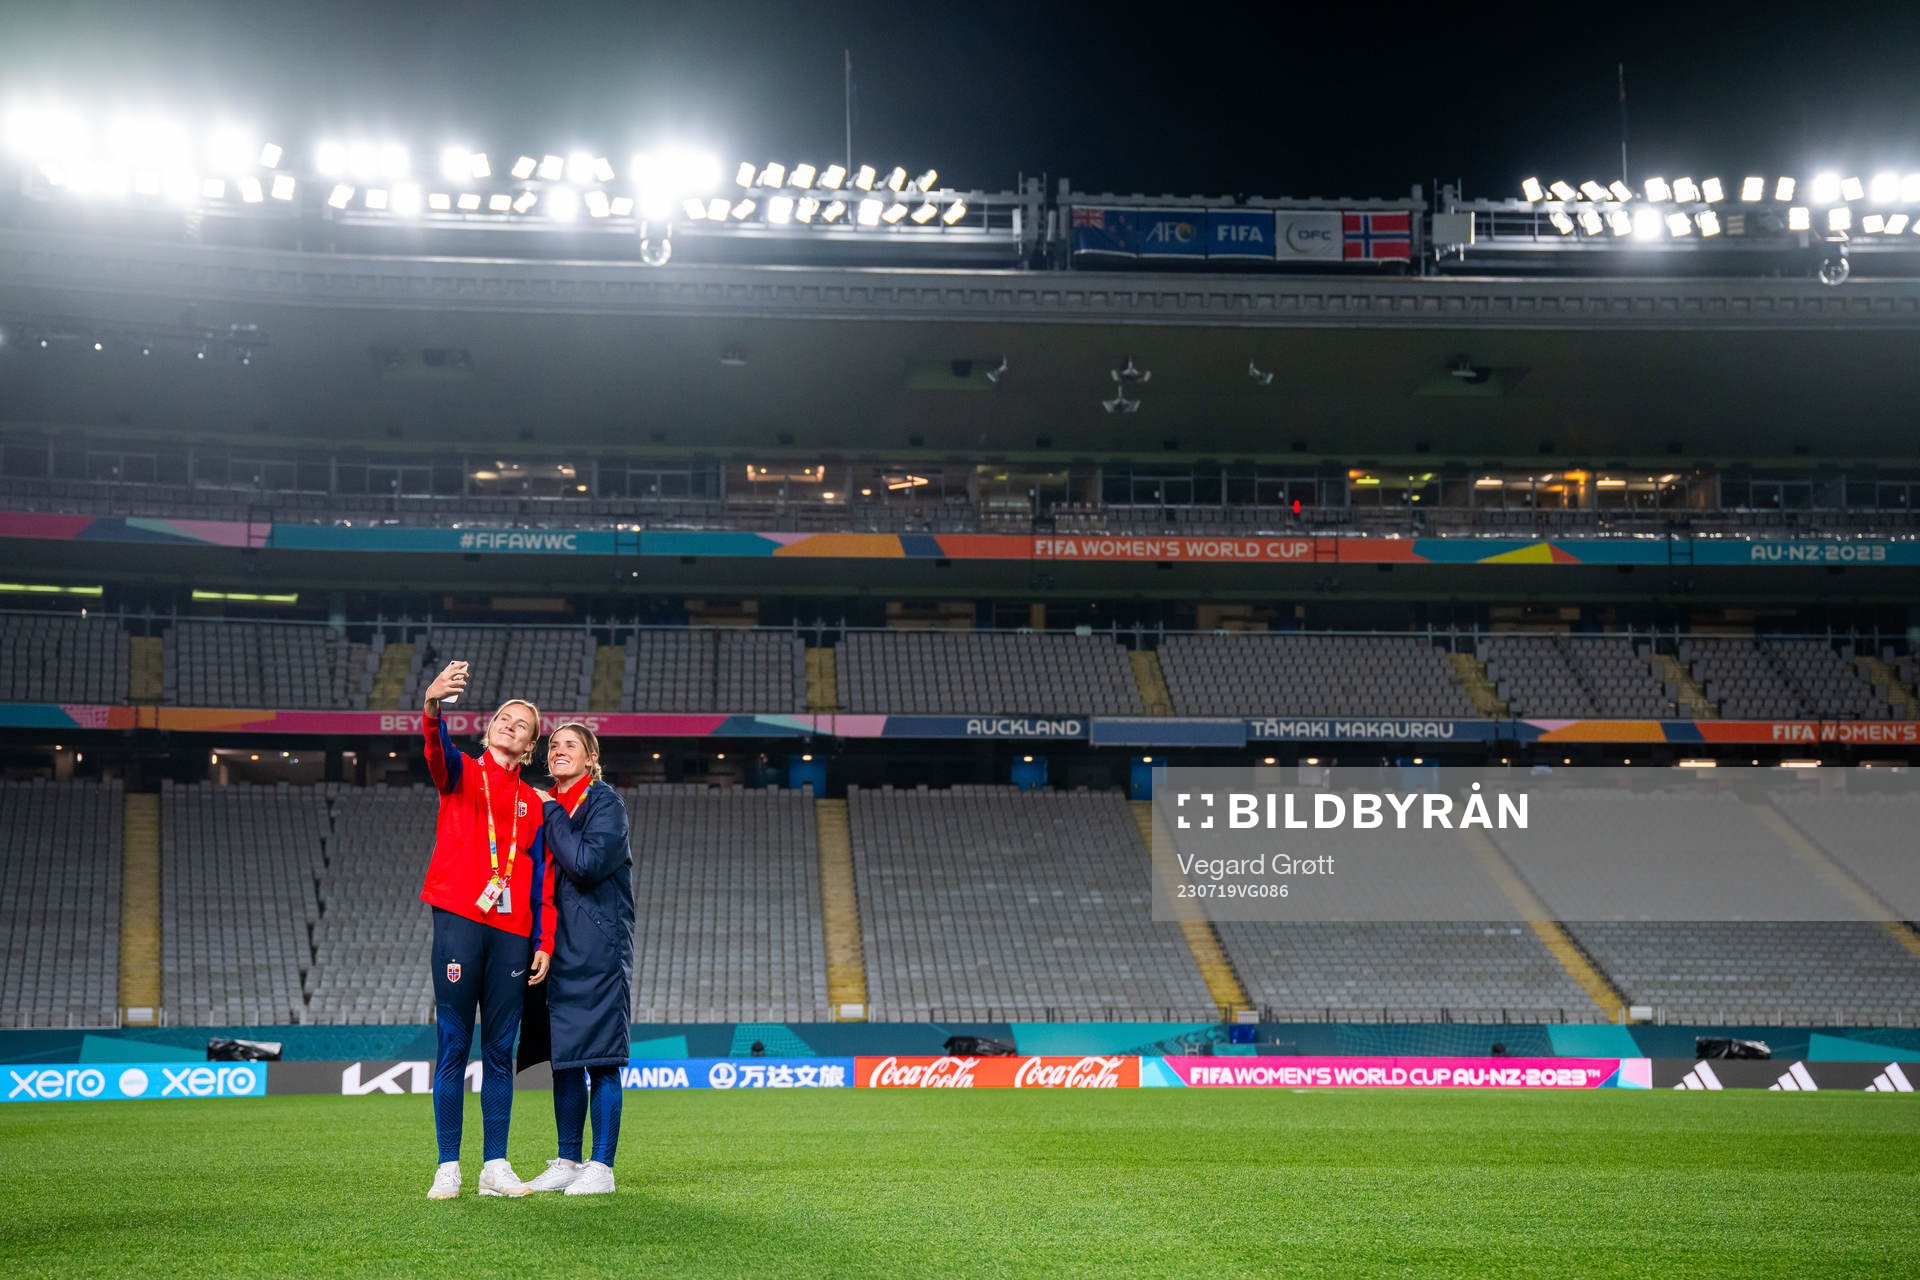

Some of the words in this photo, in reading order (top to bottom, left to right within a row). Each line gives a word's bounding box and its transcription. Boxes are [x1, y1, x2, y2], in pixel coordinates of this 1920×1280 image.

[1146, 221, 1193, 242] AFC
[1217, 225, 1263, 242] FIFA
[1297, 229, 1332, 240] OFC
[460, 533, 577, 550] #FIFAWWC
[1035, 540, 1078, 555] FIFA
[1081, 541, 1180, 556] WOMEN'S
[1185, 542, 1260, 557] WORLD
[1266, 543, 1309, 558] CUP
[966, 719, 1081, 735] AUCKLAND
[1251, 718, 1330, 737] TĀMAKI
[1335, 722, 1454, 738] MAKAURAU
[1772, 725, 1815, 740] FIFA
[1821, 725, 1917, 740] WOMEN'S
[9, 1069, 105, 1098] xero
[162, 1067, 256, 1096] xero
[739, 1065, 845, 1088] 万达文旅
[1190, 1067, 1235, 1084] FIFA
[1234, 1067, 1331, 1085] WOMEN'S
[1334, 1067, 1408, 1085] WORLD
[1409, 1068, 1451, 1085] CUP
